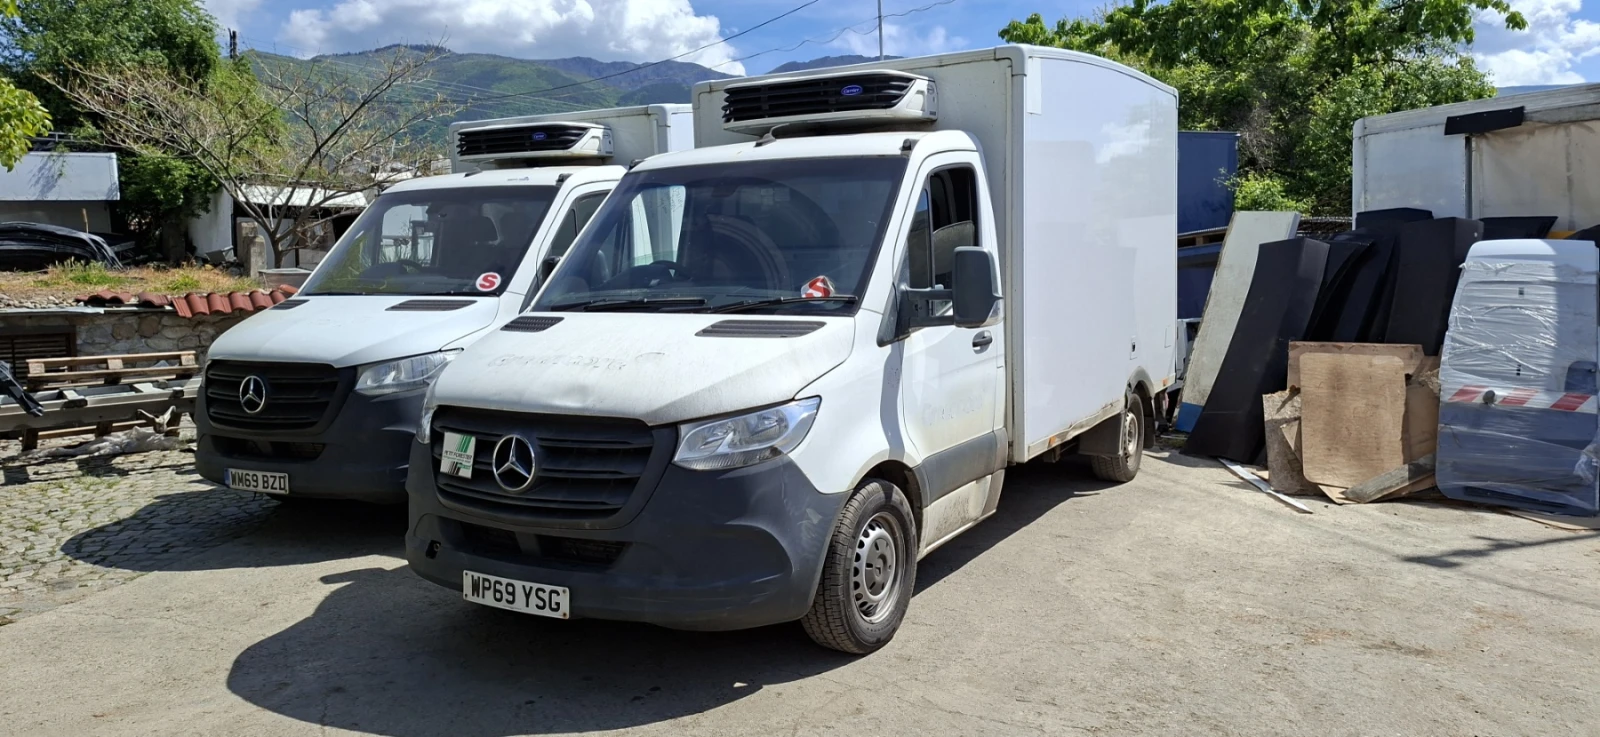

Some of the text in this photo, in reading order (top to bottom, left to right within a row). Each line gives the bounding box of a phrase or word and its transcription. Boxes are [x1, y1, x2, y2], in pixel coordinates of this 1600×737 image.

[479, 274, 498, 289] S
[805, 278, 830, 298] S
[230, 471, 286, 491] WM69 BZD
[471, 574, 561, 612] WP69 YSG
